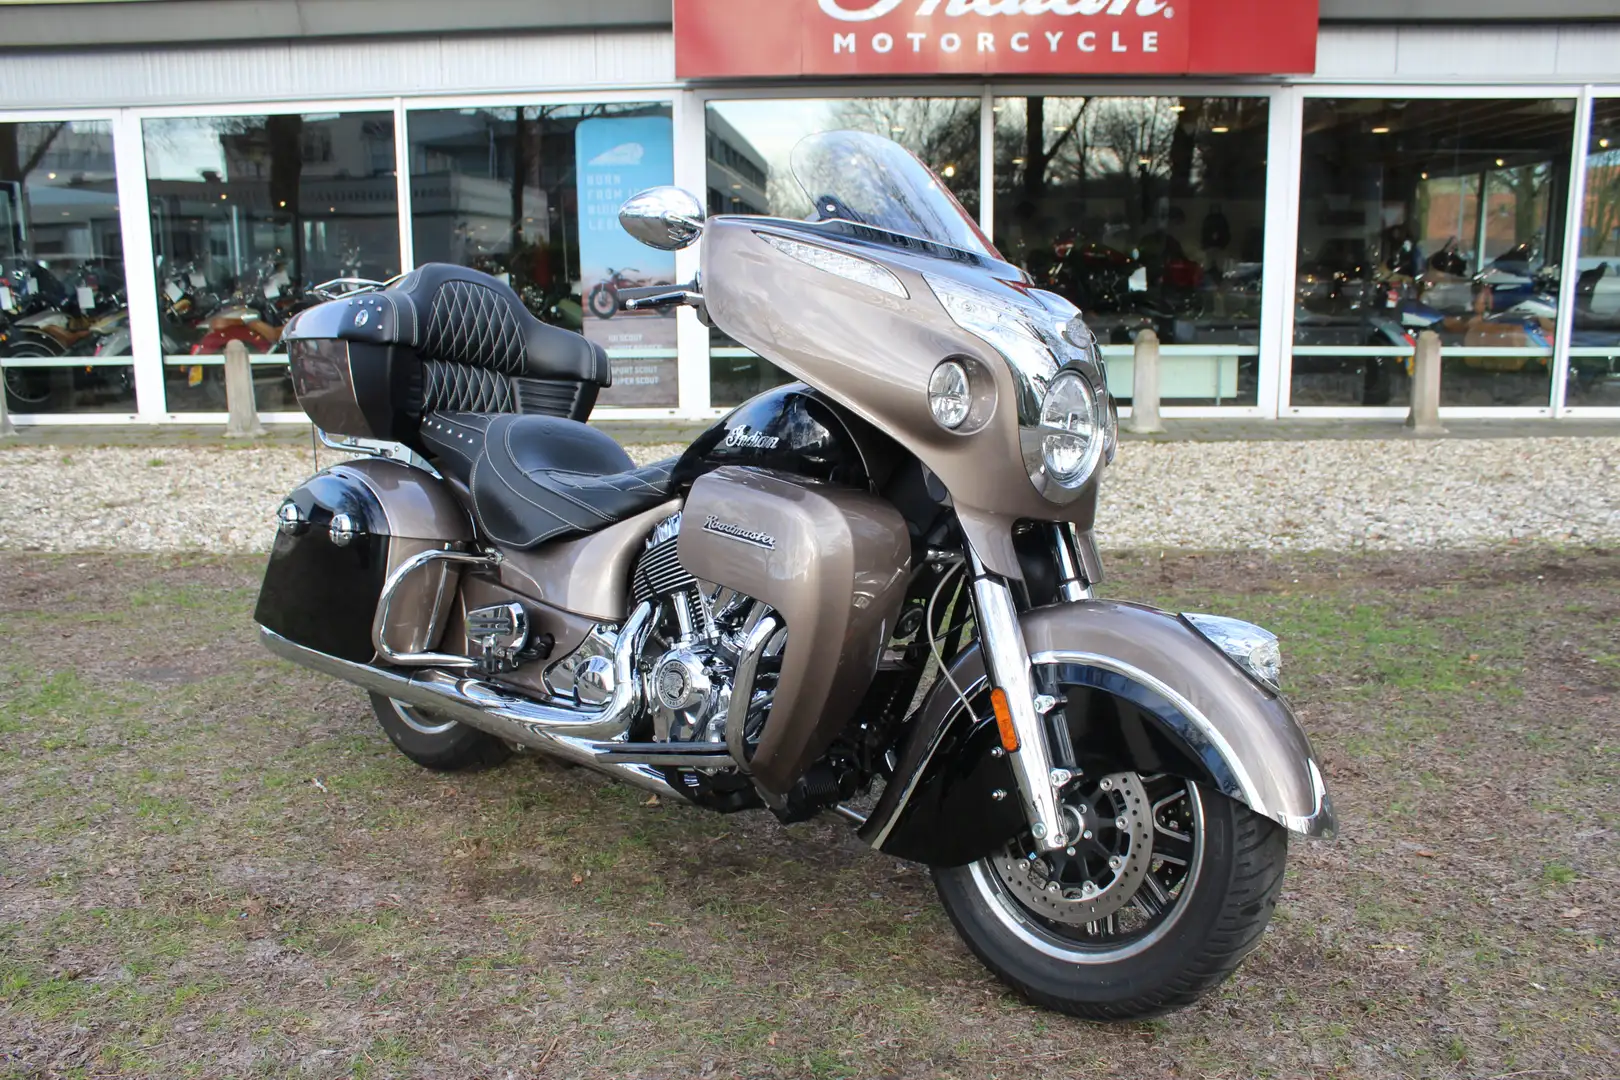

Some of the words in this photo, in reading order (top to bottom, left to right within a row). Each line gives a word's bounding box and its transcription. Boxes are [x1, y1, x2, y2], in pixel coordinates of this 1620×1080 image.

[833, 32, 1159, 53] MOTORCYCLE
[635, 377, 659, 385] SCOUT
[725, 424, 780, 449] Indian
[703, 515, 776, 546] Roadmaster
